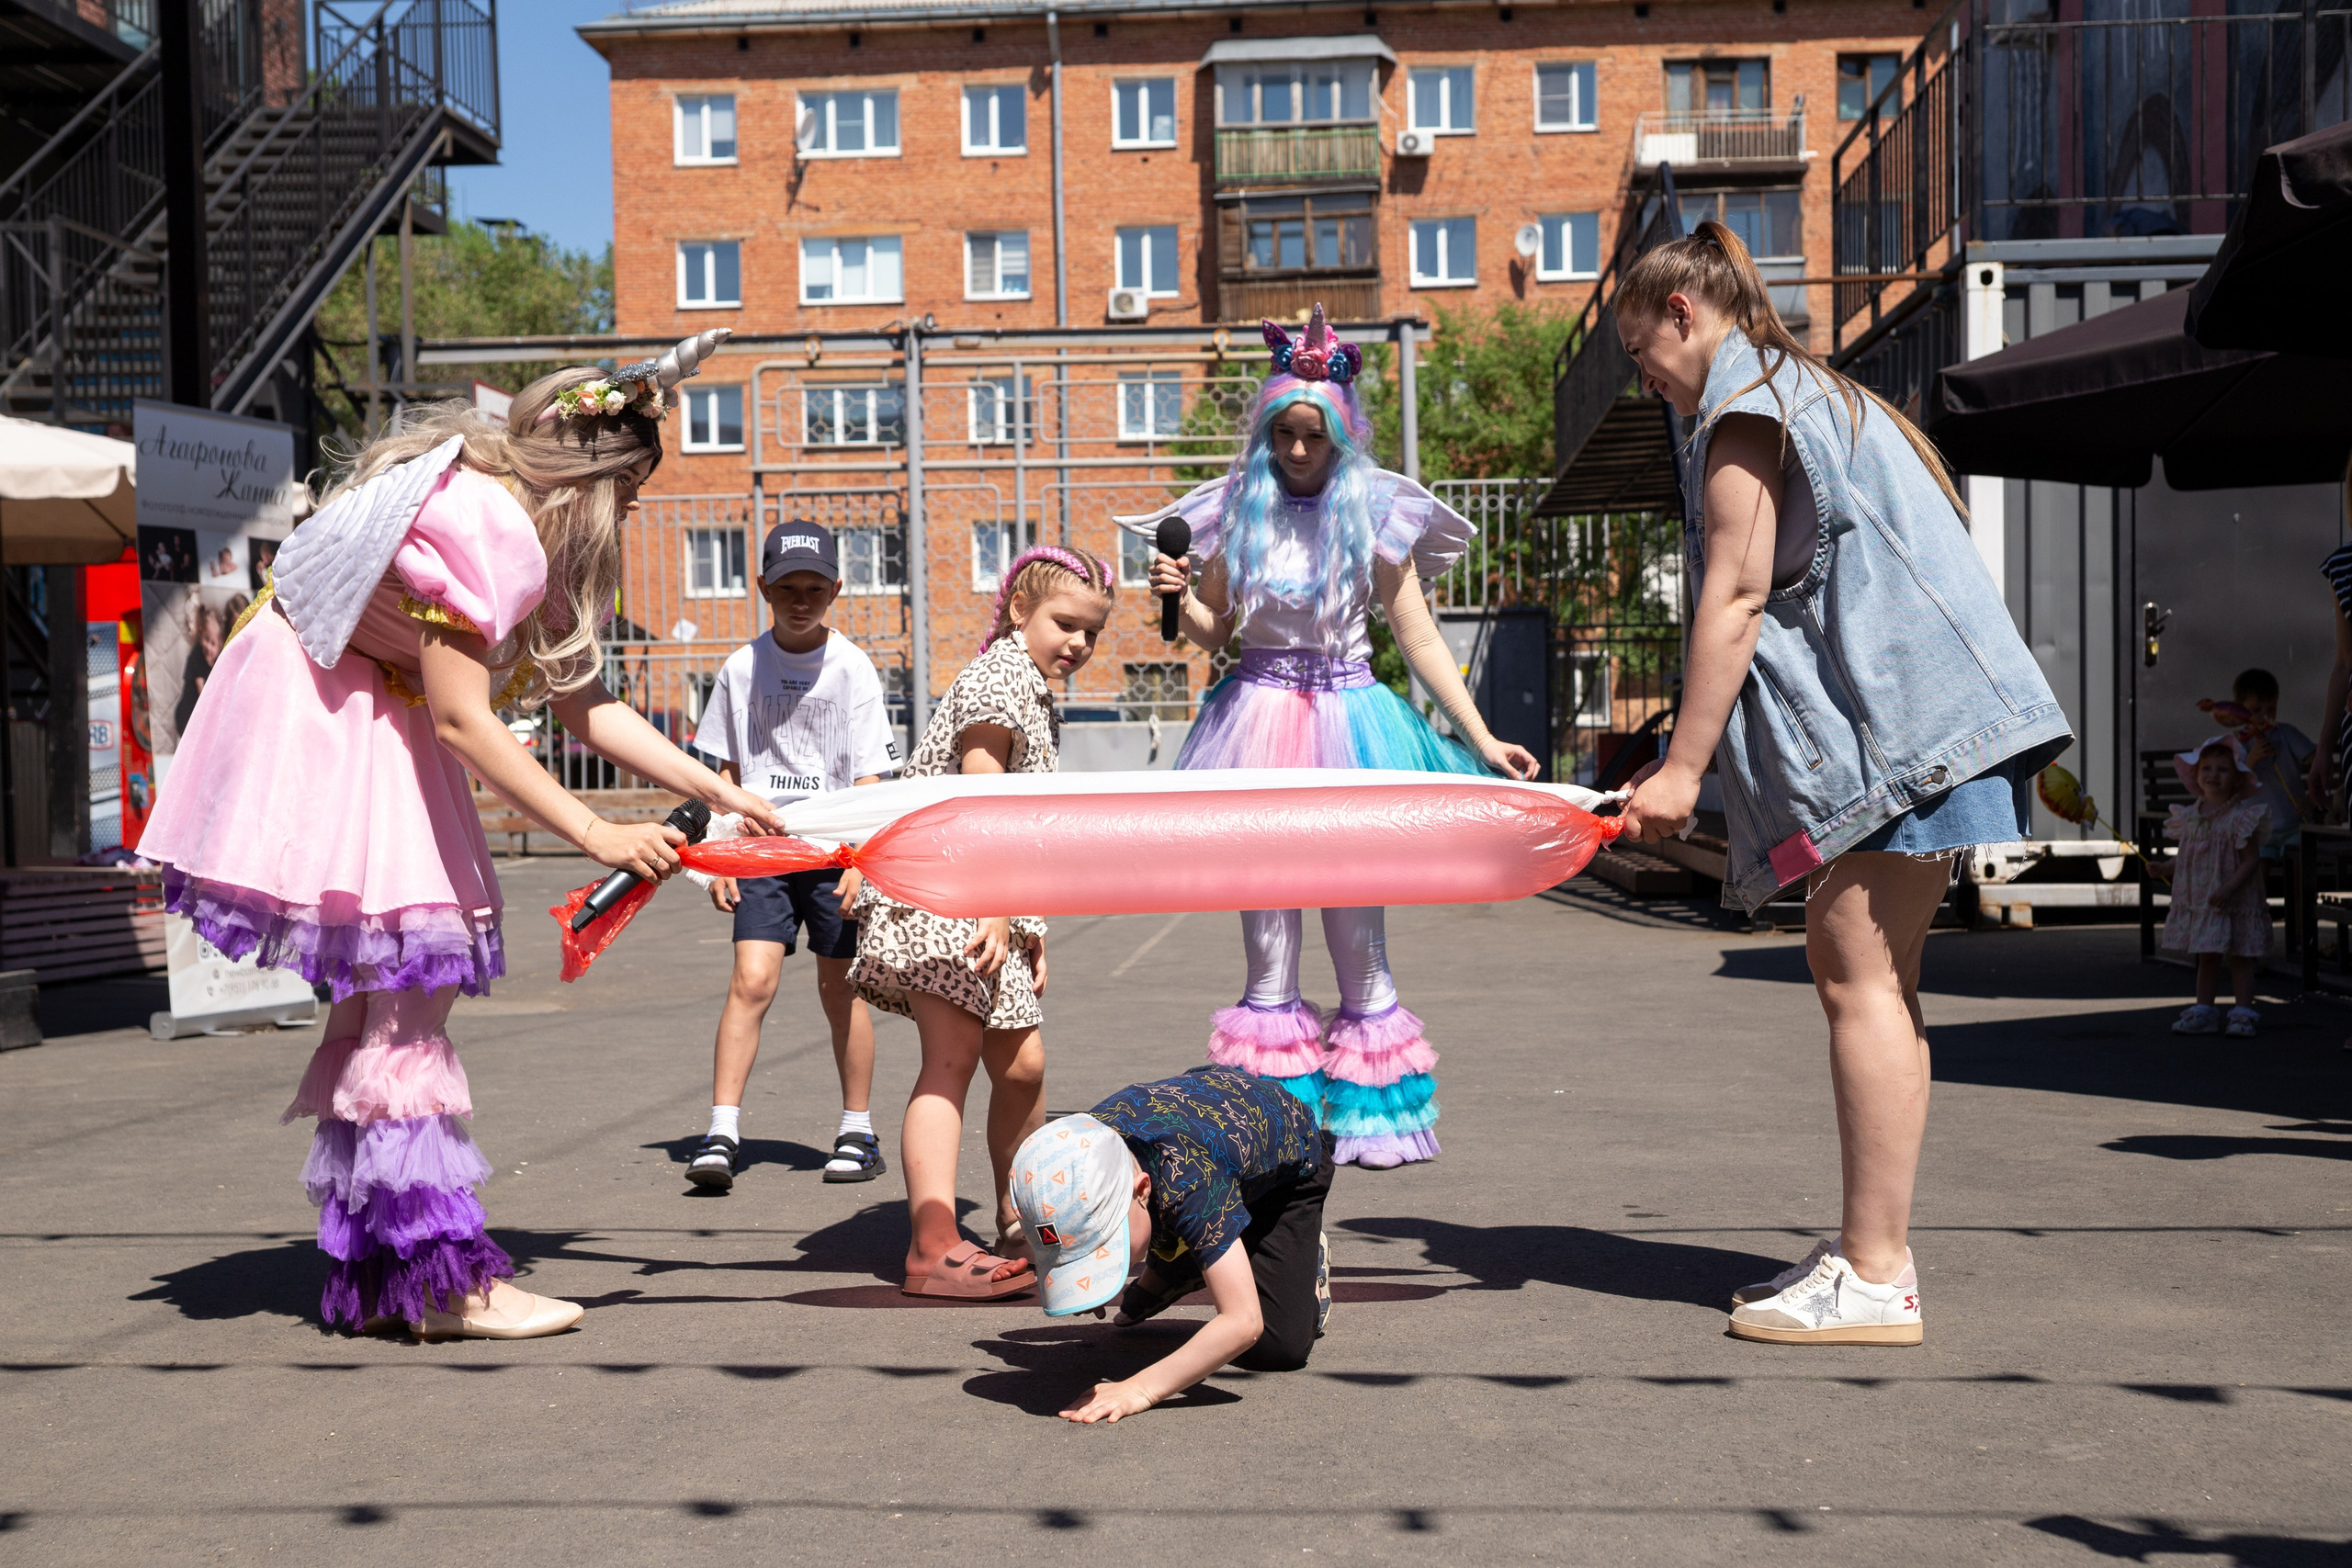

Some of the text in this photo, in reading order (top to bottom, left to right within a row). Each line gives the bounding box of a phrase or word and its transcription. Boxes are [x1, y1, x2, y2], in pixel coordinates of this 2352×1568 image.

[139, 424, 268, 472] Агафонова
[212, 468, 288, 506] Жанна
[780, 535, 820, 554] EVERLAST
[770, 774, 820, 790] THINGS
